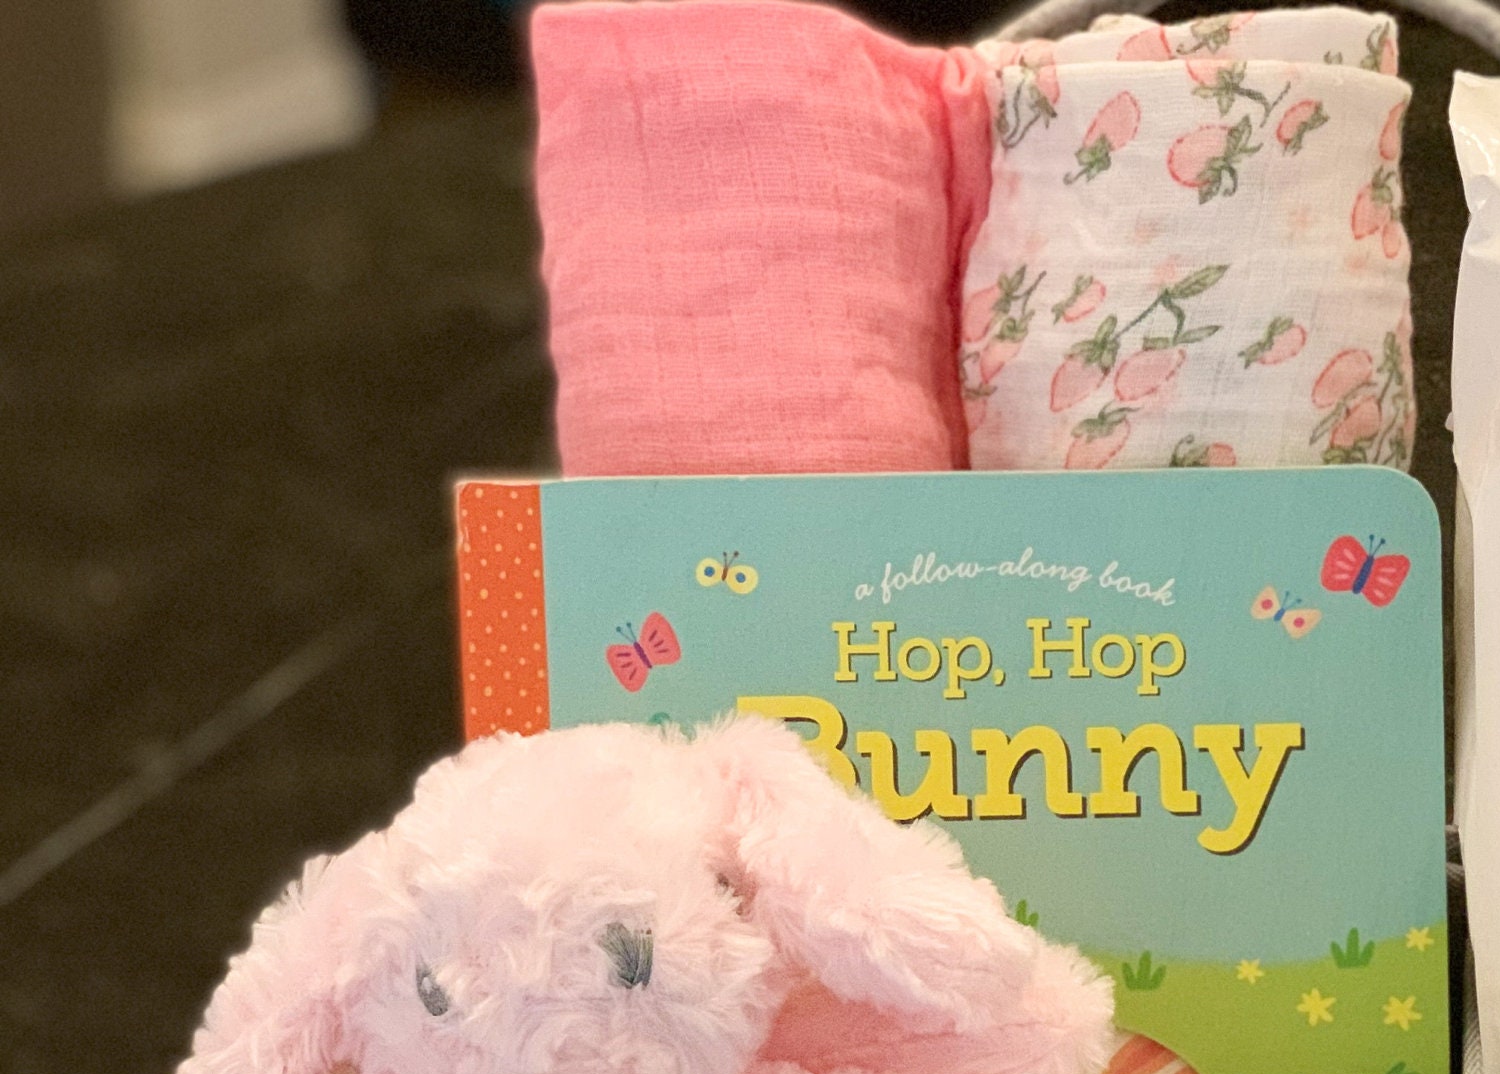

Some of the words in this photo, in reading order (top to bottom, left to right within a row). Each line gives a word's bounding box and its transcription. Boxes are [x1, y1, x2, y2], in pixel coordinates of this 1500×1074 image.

[855, 582, 874, 600] a
[881, 546, 1092, 604] follow-along
[1099, 561, 1176, 606] book
[832, 620, 1006, 700] Hop,
[1026, 617, 1187, 696] Hop
